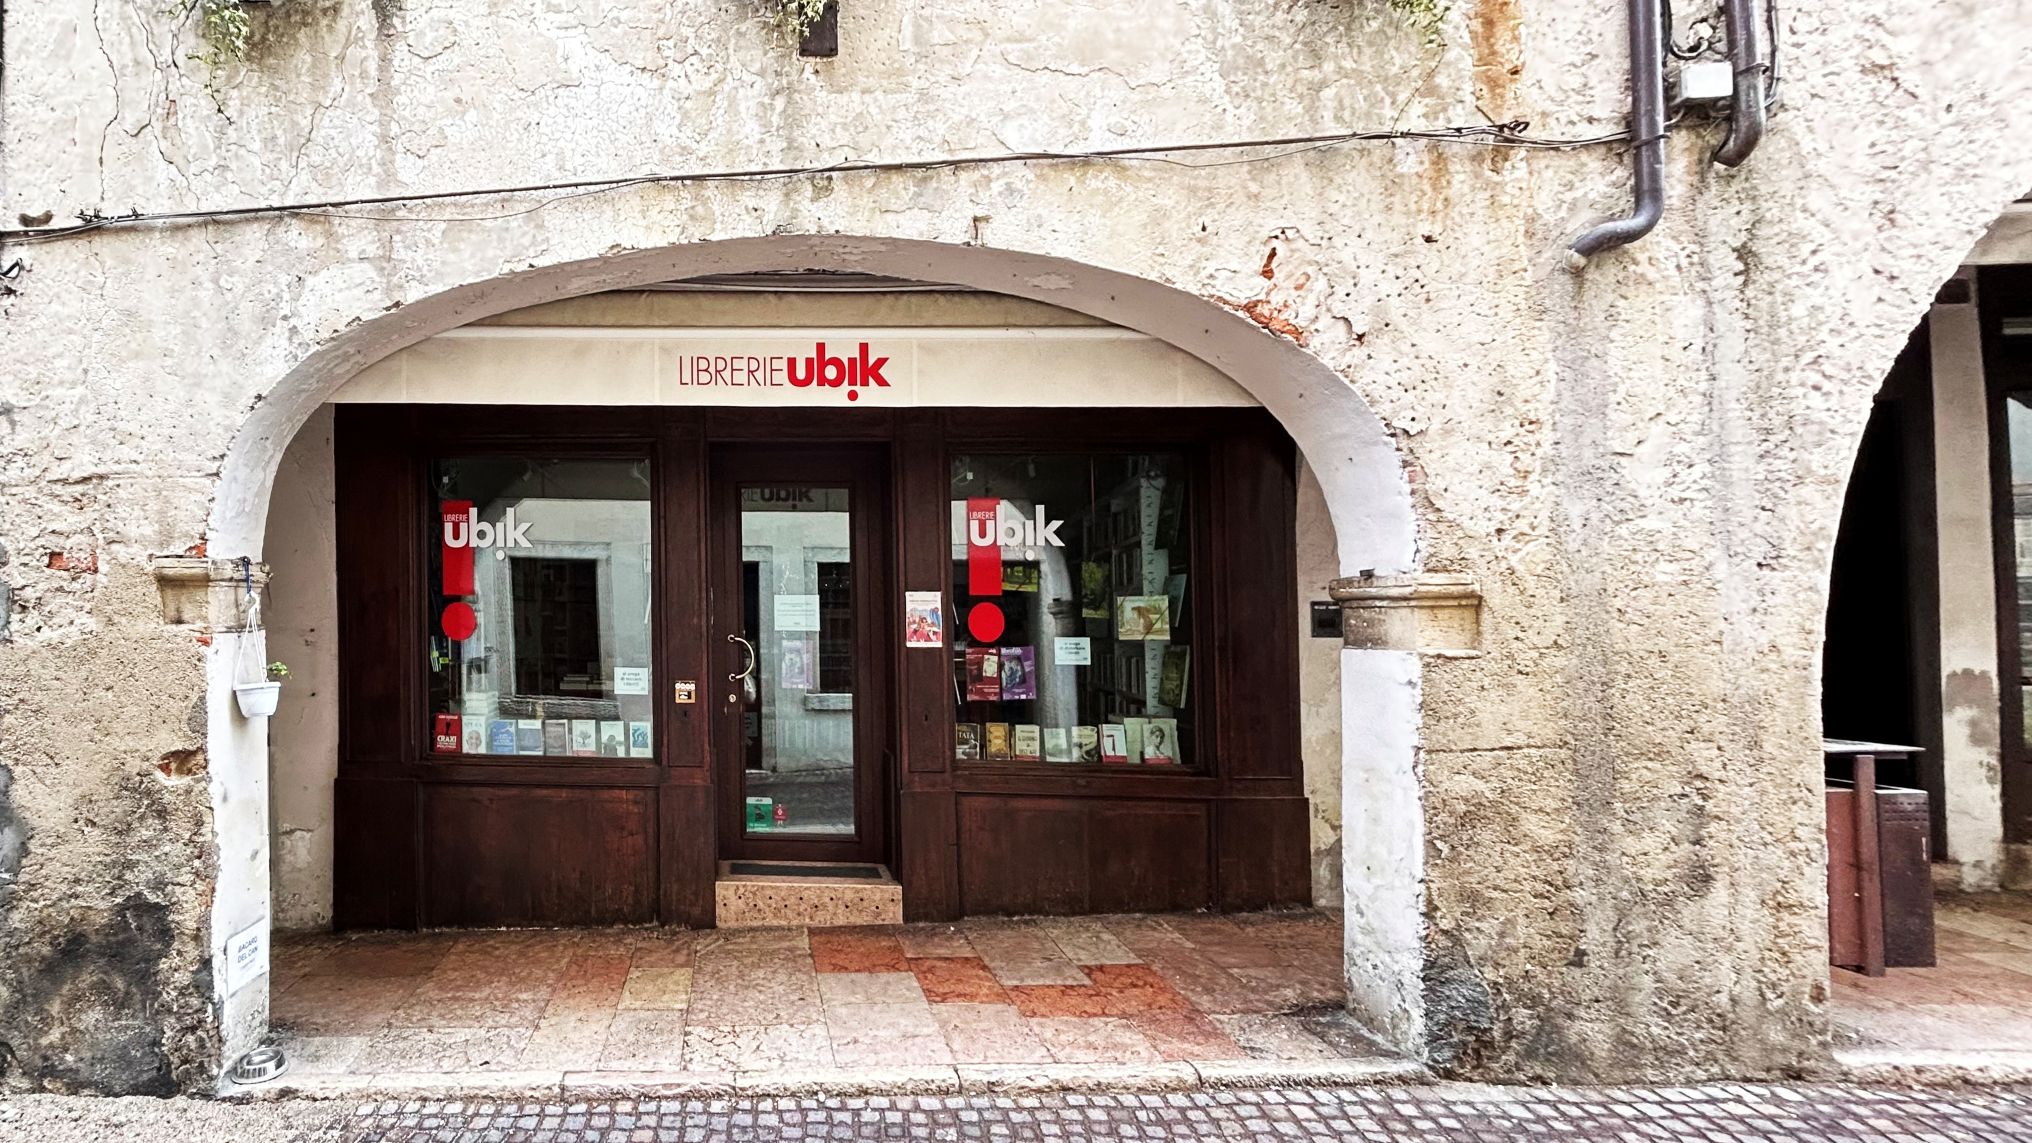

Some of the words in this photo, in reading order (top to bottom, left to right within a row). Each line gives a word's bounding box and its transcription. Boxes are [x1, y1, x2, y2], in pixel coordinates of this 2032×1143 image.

[679, 355, 784, 387] LIBRERIE
[787, 342, 892, 402] ubik
[443, 513, 469, 523] LIBRERIE
[969, 511, 995, 520] LIBRERIE
[444, 507, 534, 561] ubik
[969, 504, 1066, 561] ubik
[437, 735, 457, 743] CRAXI
